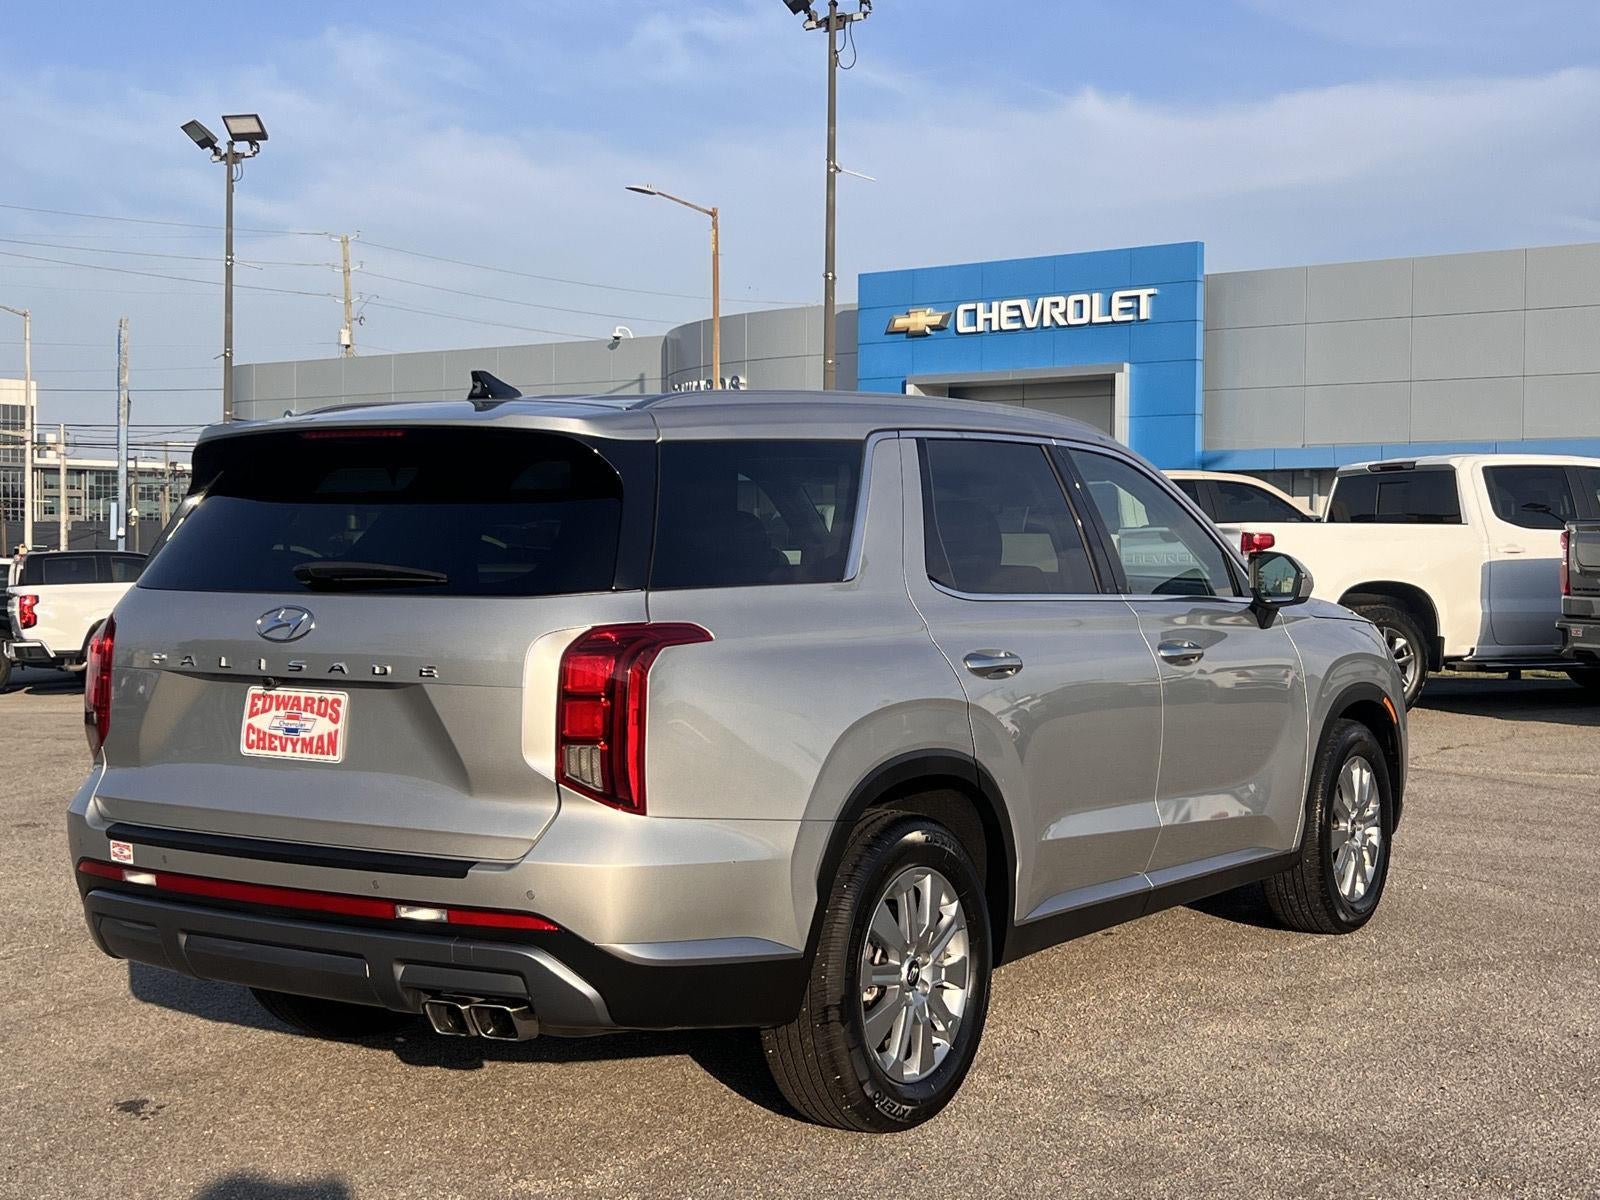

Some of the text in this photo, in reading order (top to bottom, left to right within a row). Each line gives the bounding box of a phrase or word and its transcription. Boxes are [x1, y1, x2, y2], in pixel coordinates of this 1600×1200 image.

[956, 288, 1158, 334] CHEVROLET
[151, 652, 439, 678] PALISADE
[248, 693, 342, 725] EDWARDS
[245, 722, 338, 756] CHEVYMAN
